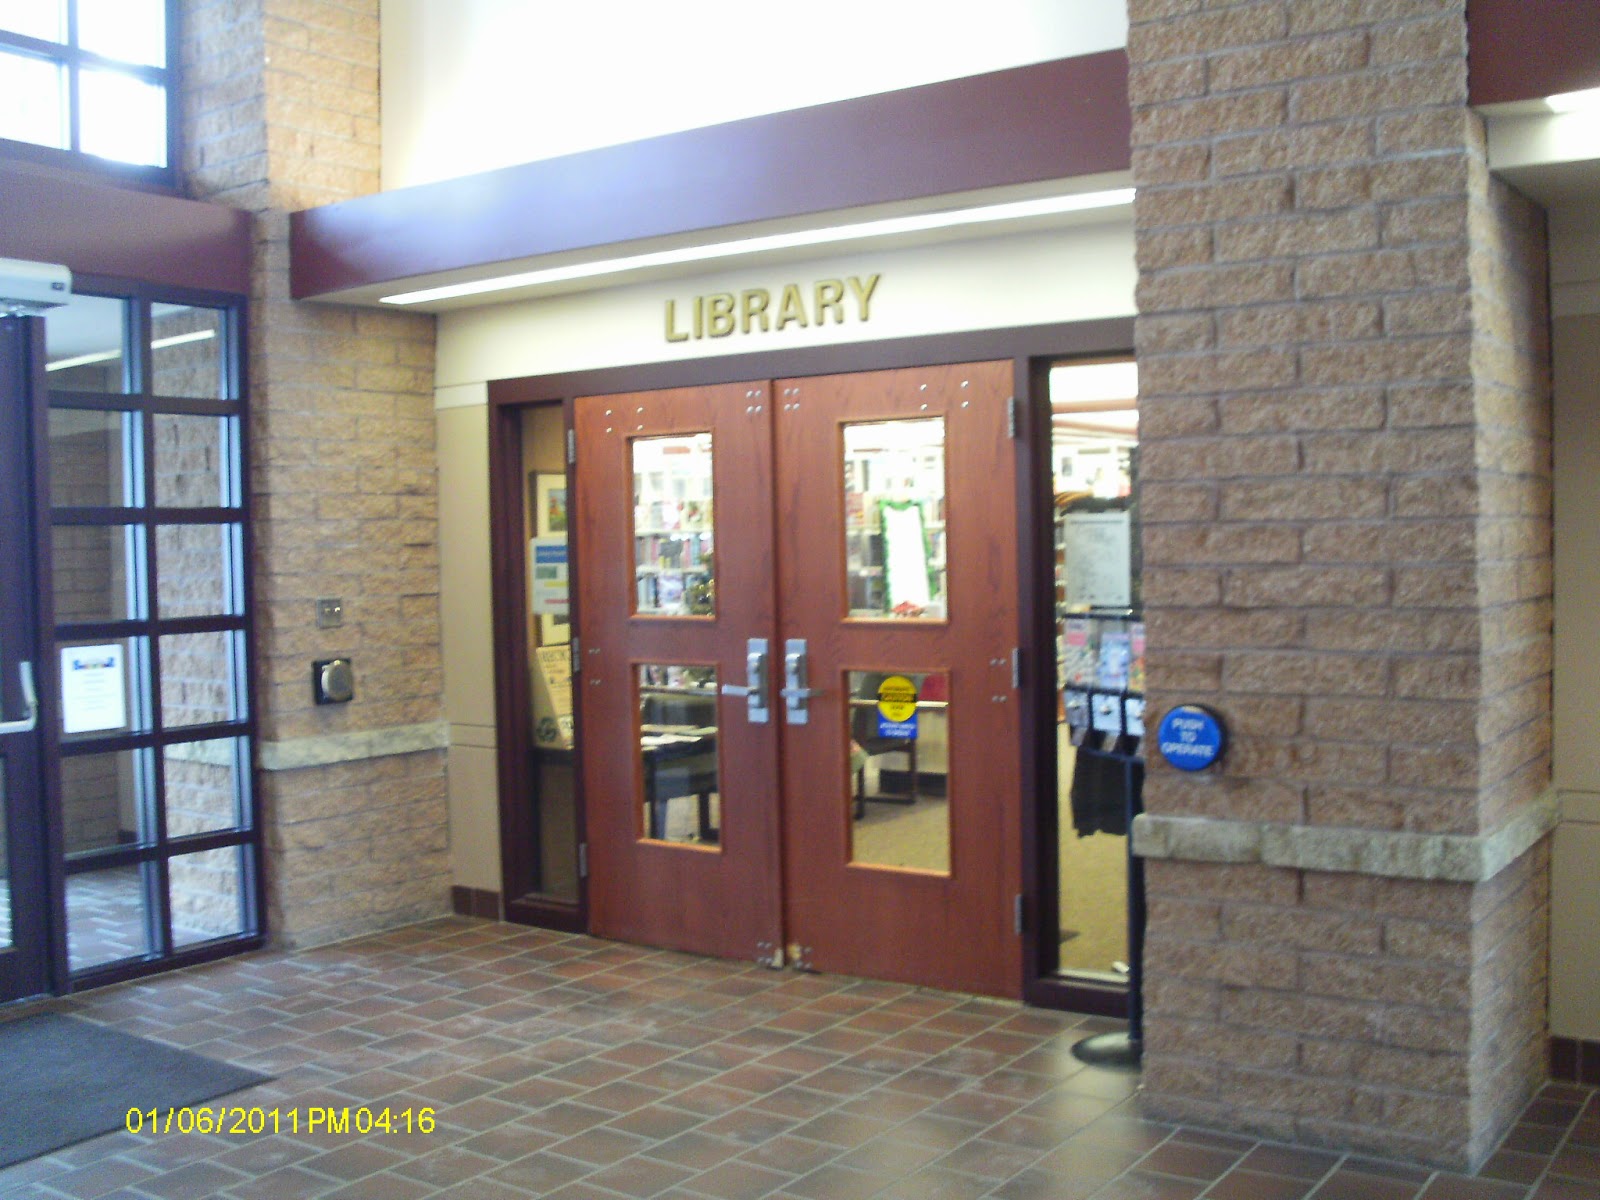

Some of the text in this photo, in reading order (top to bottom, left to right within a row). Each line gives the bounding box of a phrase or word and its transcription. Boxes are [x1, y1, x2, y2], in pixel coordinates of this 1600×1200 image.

[664, 274, 881, 343] LIBRARY
[1171, 718, 1204, 731] PUSH
[1180, 730, 1197, 743] TO
[1161, 742, 1214, 757] OPERATE
